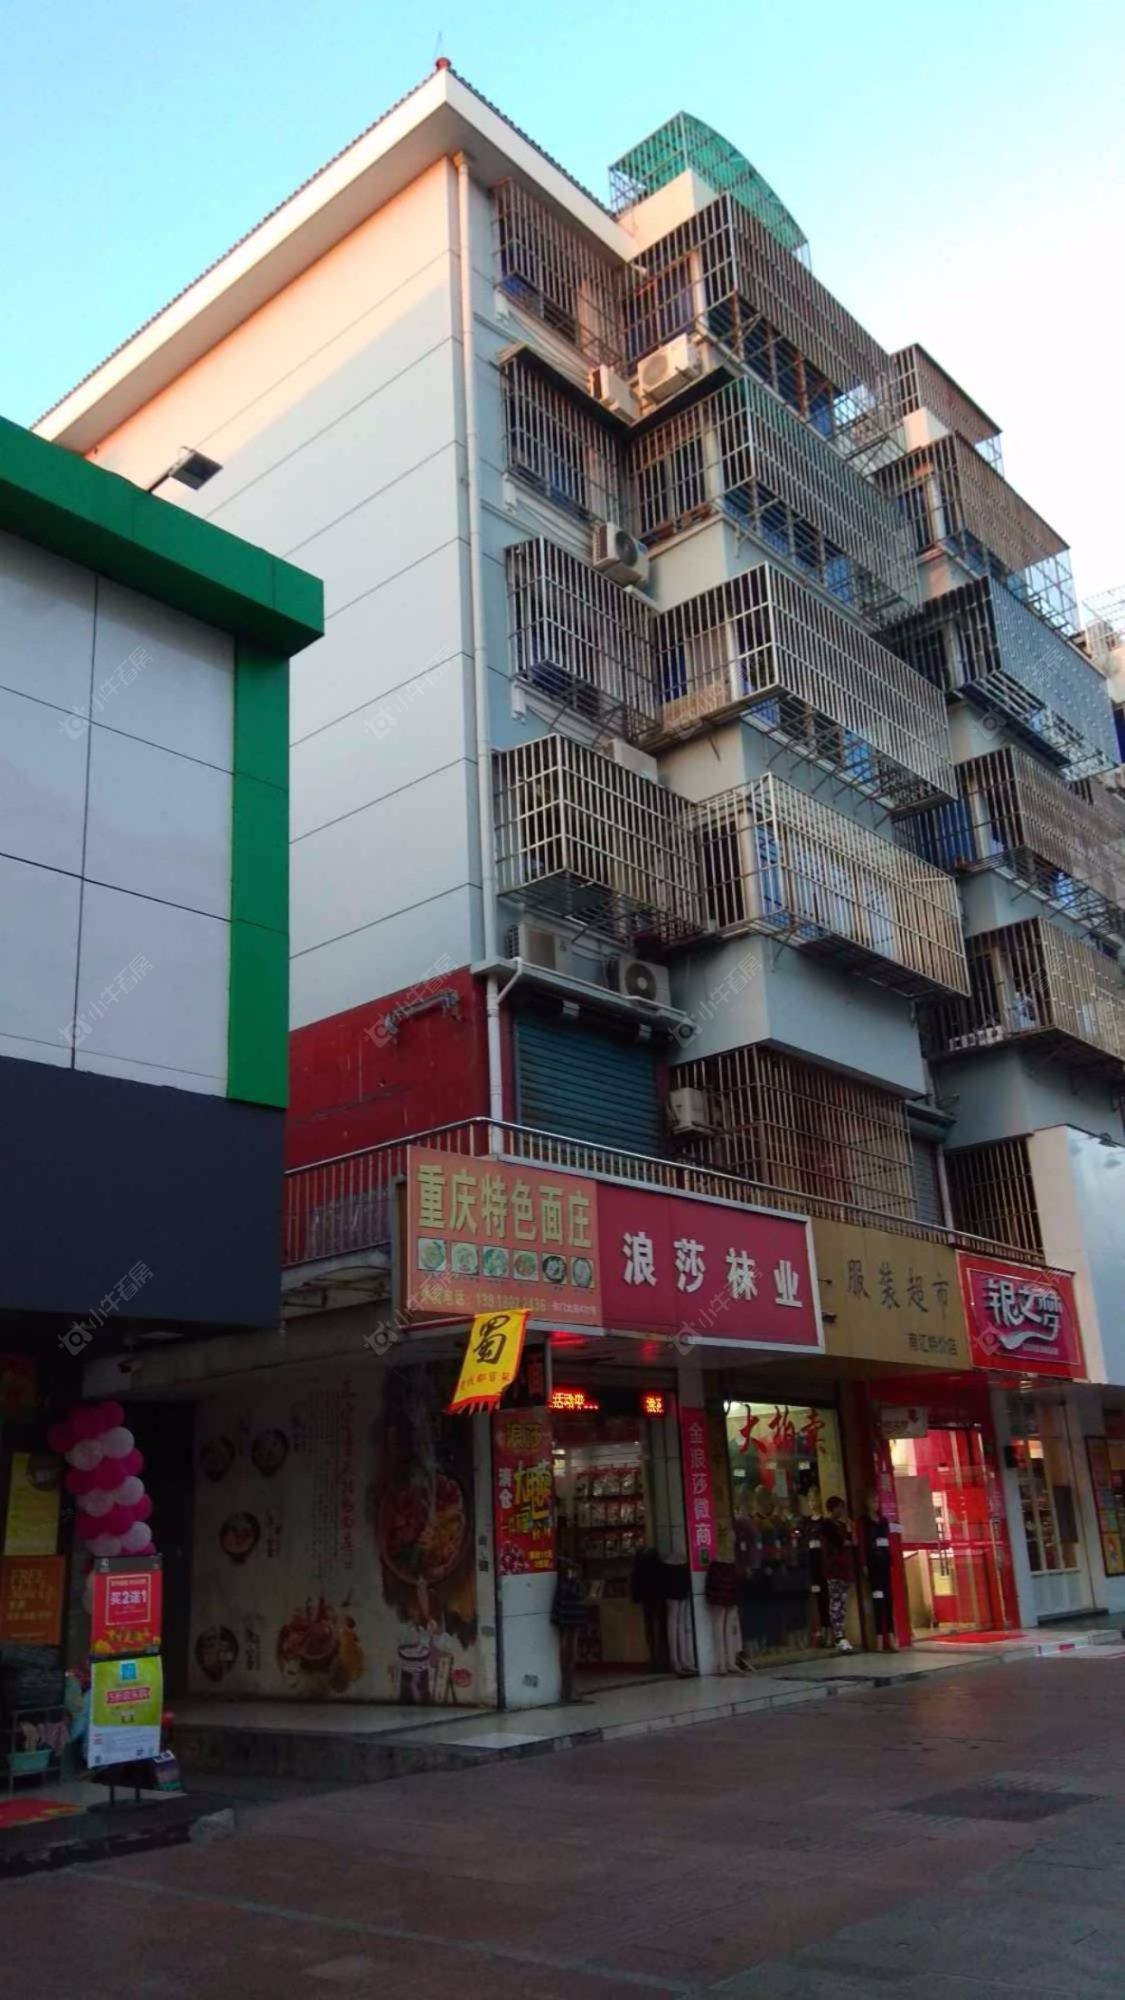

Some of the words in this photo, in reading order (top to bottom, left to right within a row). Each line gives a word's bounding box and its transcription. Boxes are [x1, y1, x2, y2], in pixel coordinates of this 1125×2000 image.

[416, 1164, 593, 1249] 重庆特色面庄
[622, 1231, 803, 1308] 浪莎袜业
[847, 1259, 950, 1320] 服装超市
[472, 1315, 511, 1364] 蜀
